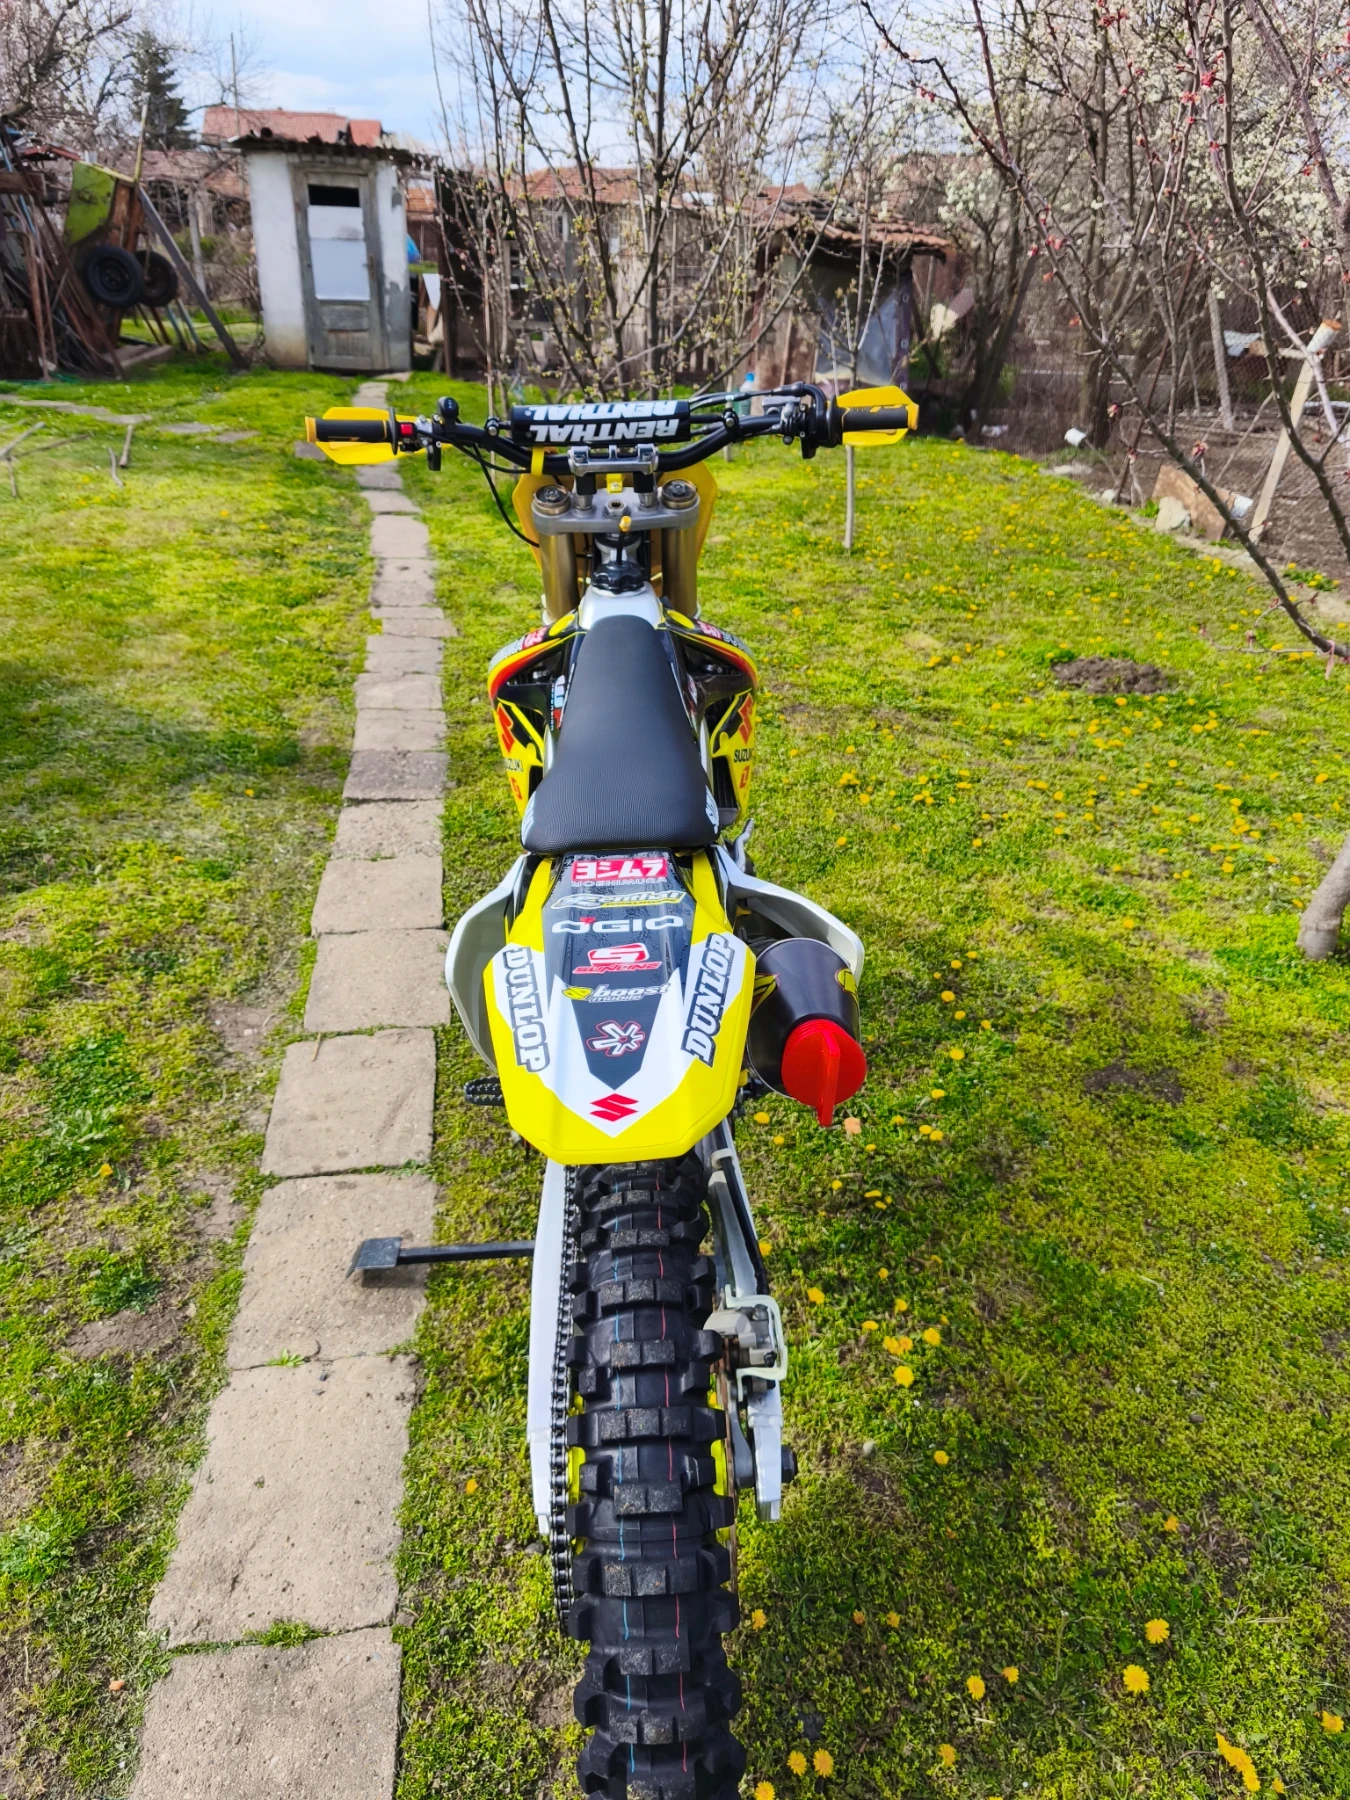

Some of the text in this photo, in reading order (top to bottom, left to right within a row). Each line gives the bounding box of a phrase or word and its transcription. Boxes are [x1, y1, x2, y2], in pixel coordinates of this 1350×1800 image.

[529, 401, 678, 421] RENTHAL
[530, 419, 680, 443] RENTHAL
[575, 859, 664, 880] ヨシムラ
[571, 877, 668, 888] YOSHIMURA
[552, 915, 684, 934] OGIO
[590, 994, 643, 1003] mobile
[594, 983, 672, 998] boost
[682, 933, 735, 1068] DUNLOP
[503, 946, 551, 1073] DUNLOP
